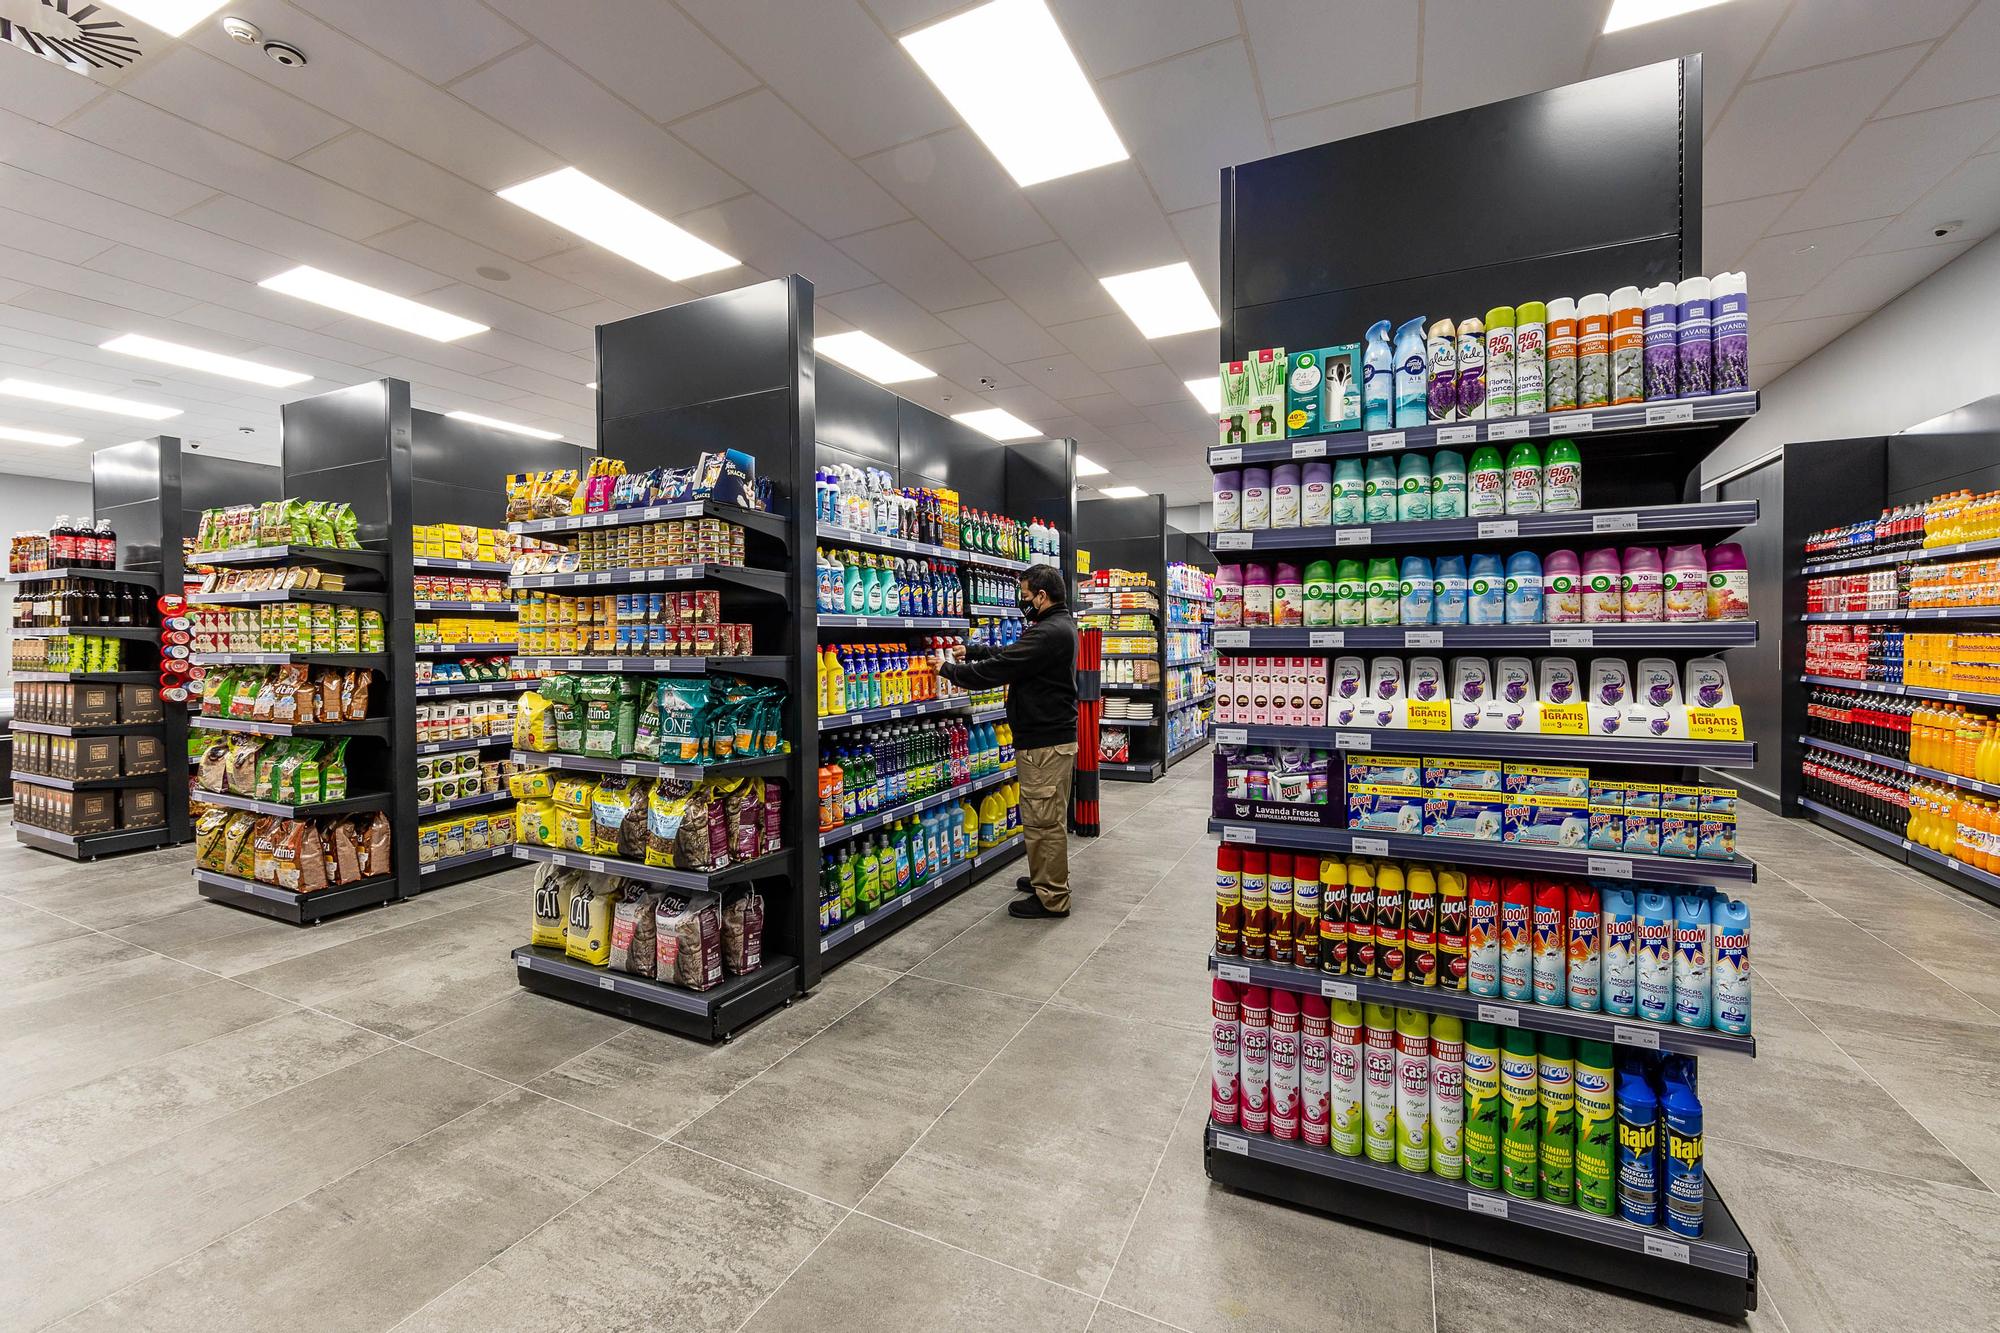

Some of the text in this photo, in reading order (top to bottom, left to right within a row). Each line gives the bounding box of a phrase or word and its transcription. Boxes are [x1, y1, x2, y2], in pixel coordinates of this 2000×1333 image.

[1680, 328, 1710, 338] LAVANDA
[1714, 322, 1746, 334] LAVANDA
[1489, 336, 1508, 348] Bio
[1517, 331, 1537, 344] Bio
[1552, 348, 1574, 356] BLANCAS
[1582, 344, 1604, 352] BLANCAS
[1429, 352, 1456, 372] glade
[727, 470, 746, 479] SNACKS
[1477, 474, 1496, 482] Bio
[1513, 470, 1532, 480] Bio
[1550, 466, 1570, 478] Bio
[1415, 708, 1447, 718] GRATIS
[1547, 712, 1584, 720] GRATIS
[663, 717, 692, 734] ONE
[1698, 717, 1738, 726] GRATIS
[1350, 766, 1367, 774] BLOOM
[1426, 769, 1445, 778] BLOOM
[1282, 786, 1302, 797] POLIL
[1350, 796, 1372, 805] BLOOM
[1425, 801, 1448, 811] BLOOM
[1256, 805, 1319, 818] Lavanda Fresca
[1272, 882, 1292, 890] MICAL
[1324, 888, 1347, 902] CUCAL
[1350, 890, 1374, 904] CUCAL
[1377, 894, 1402, 907] CUCAL
[536, 889, 557, 917] CAT
[1408, 897, 1434, 910] CUCAL
[1440, 900, 1467, 914] CUCAL
[571, 896, 590, 928] CAT
[1638, 925, 1671, 939] BLOOM
[1714, 934, 1749, 948] BLOOM
[1572, 975, 1598, 983] MOSCAS
[1641, 981, 1668, 990] MOSCAS
[1719, 992, 1748, 1001] MOSCAS
[1215, 1003, 1236, 1013] FORMATO
[1216, 1012, 1236, 1020] AHORRO
[1244, 1010, 1267, 1019] FORMATO
[1272, 1013, 1295, 1024] FORMATO
[1246, 1017, 1266, 1026] AHORRO
[1273, 1021, 1294, 1032] AHORRO
[1302, 1016, 1326, 1028] FORMATO
[1215, 1027, 1236, 1042] casa
[1304, 1026, 1324, 1036] AHORRO
[1332, 1021, 1354, 1036] FORMATO
[1246, 1034, 1267, 1047] casa
[1332, 1031, 1353, 1044] AHORRO
[1273, 1038, 1294, 1053] casa
[1303, 1043, 1325, 1057] casa
[1332, 1049, 1354, 1066] casa
[1502, 1060, 1533, 1074] MICAL
[1305, 1087, 1322, 1095] ROSAS
[1469, 1084, 1485, 1093] Hogar
[1509, 1094, 1527, 1102] Hogar
[1544, 1096, 1562, 1106] Hogar
[1580, 1104, 1597, 1114] Hogar
[1466, 1128, 1493, 1144] ELIMINA
[1619, 1123, 1655, 1148] Raid
[1470, 1137, 1496, 1150] INSECTOS
[1504, 1138, 1534, 1151] ELIMINA
[1540, 1142, 1570, 1156] ELIMINA
[1510, 1148, 1536, 1158] INSECTOS
[1545, 1153, 1572, 1164] INSECTOS
[1576, 1150, 1606, 1167] ELIMINA
[1581, 1161, 1609, 1174] INSECTOS
[1622, 1166, 1648, 1178] MOSCAS
[1620, 1171, 1654, 1184] MOSQUITOS
[1673, 1180, 1699, 1189] MOSCAS
